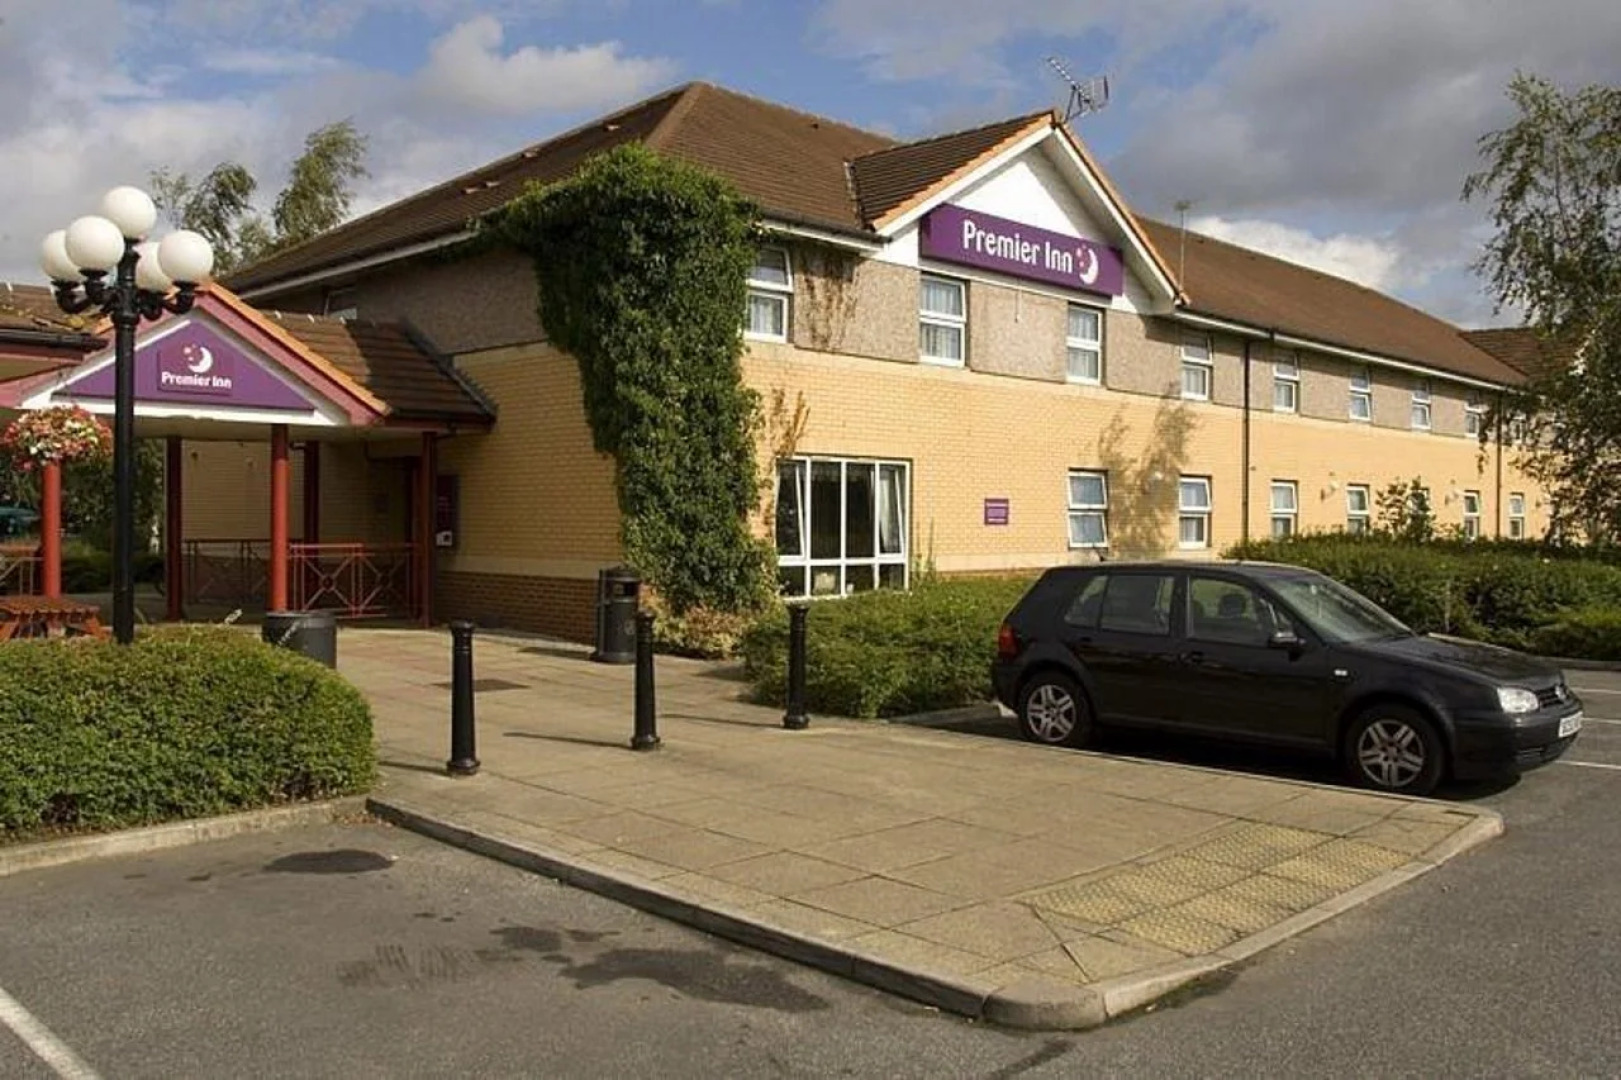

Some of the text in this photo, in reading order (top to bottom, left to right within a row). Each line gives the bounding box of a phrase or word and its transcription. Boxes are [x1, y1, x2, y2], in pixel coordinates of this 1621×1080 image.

[963, 219, 1073, 273] Premier Inn
[161, 371, 232, 388] Premier Inn
